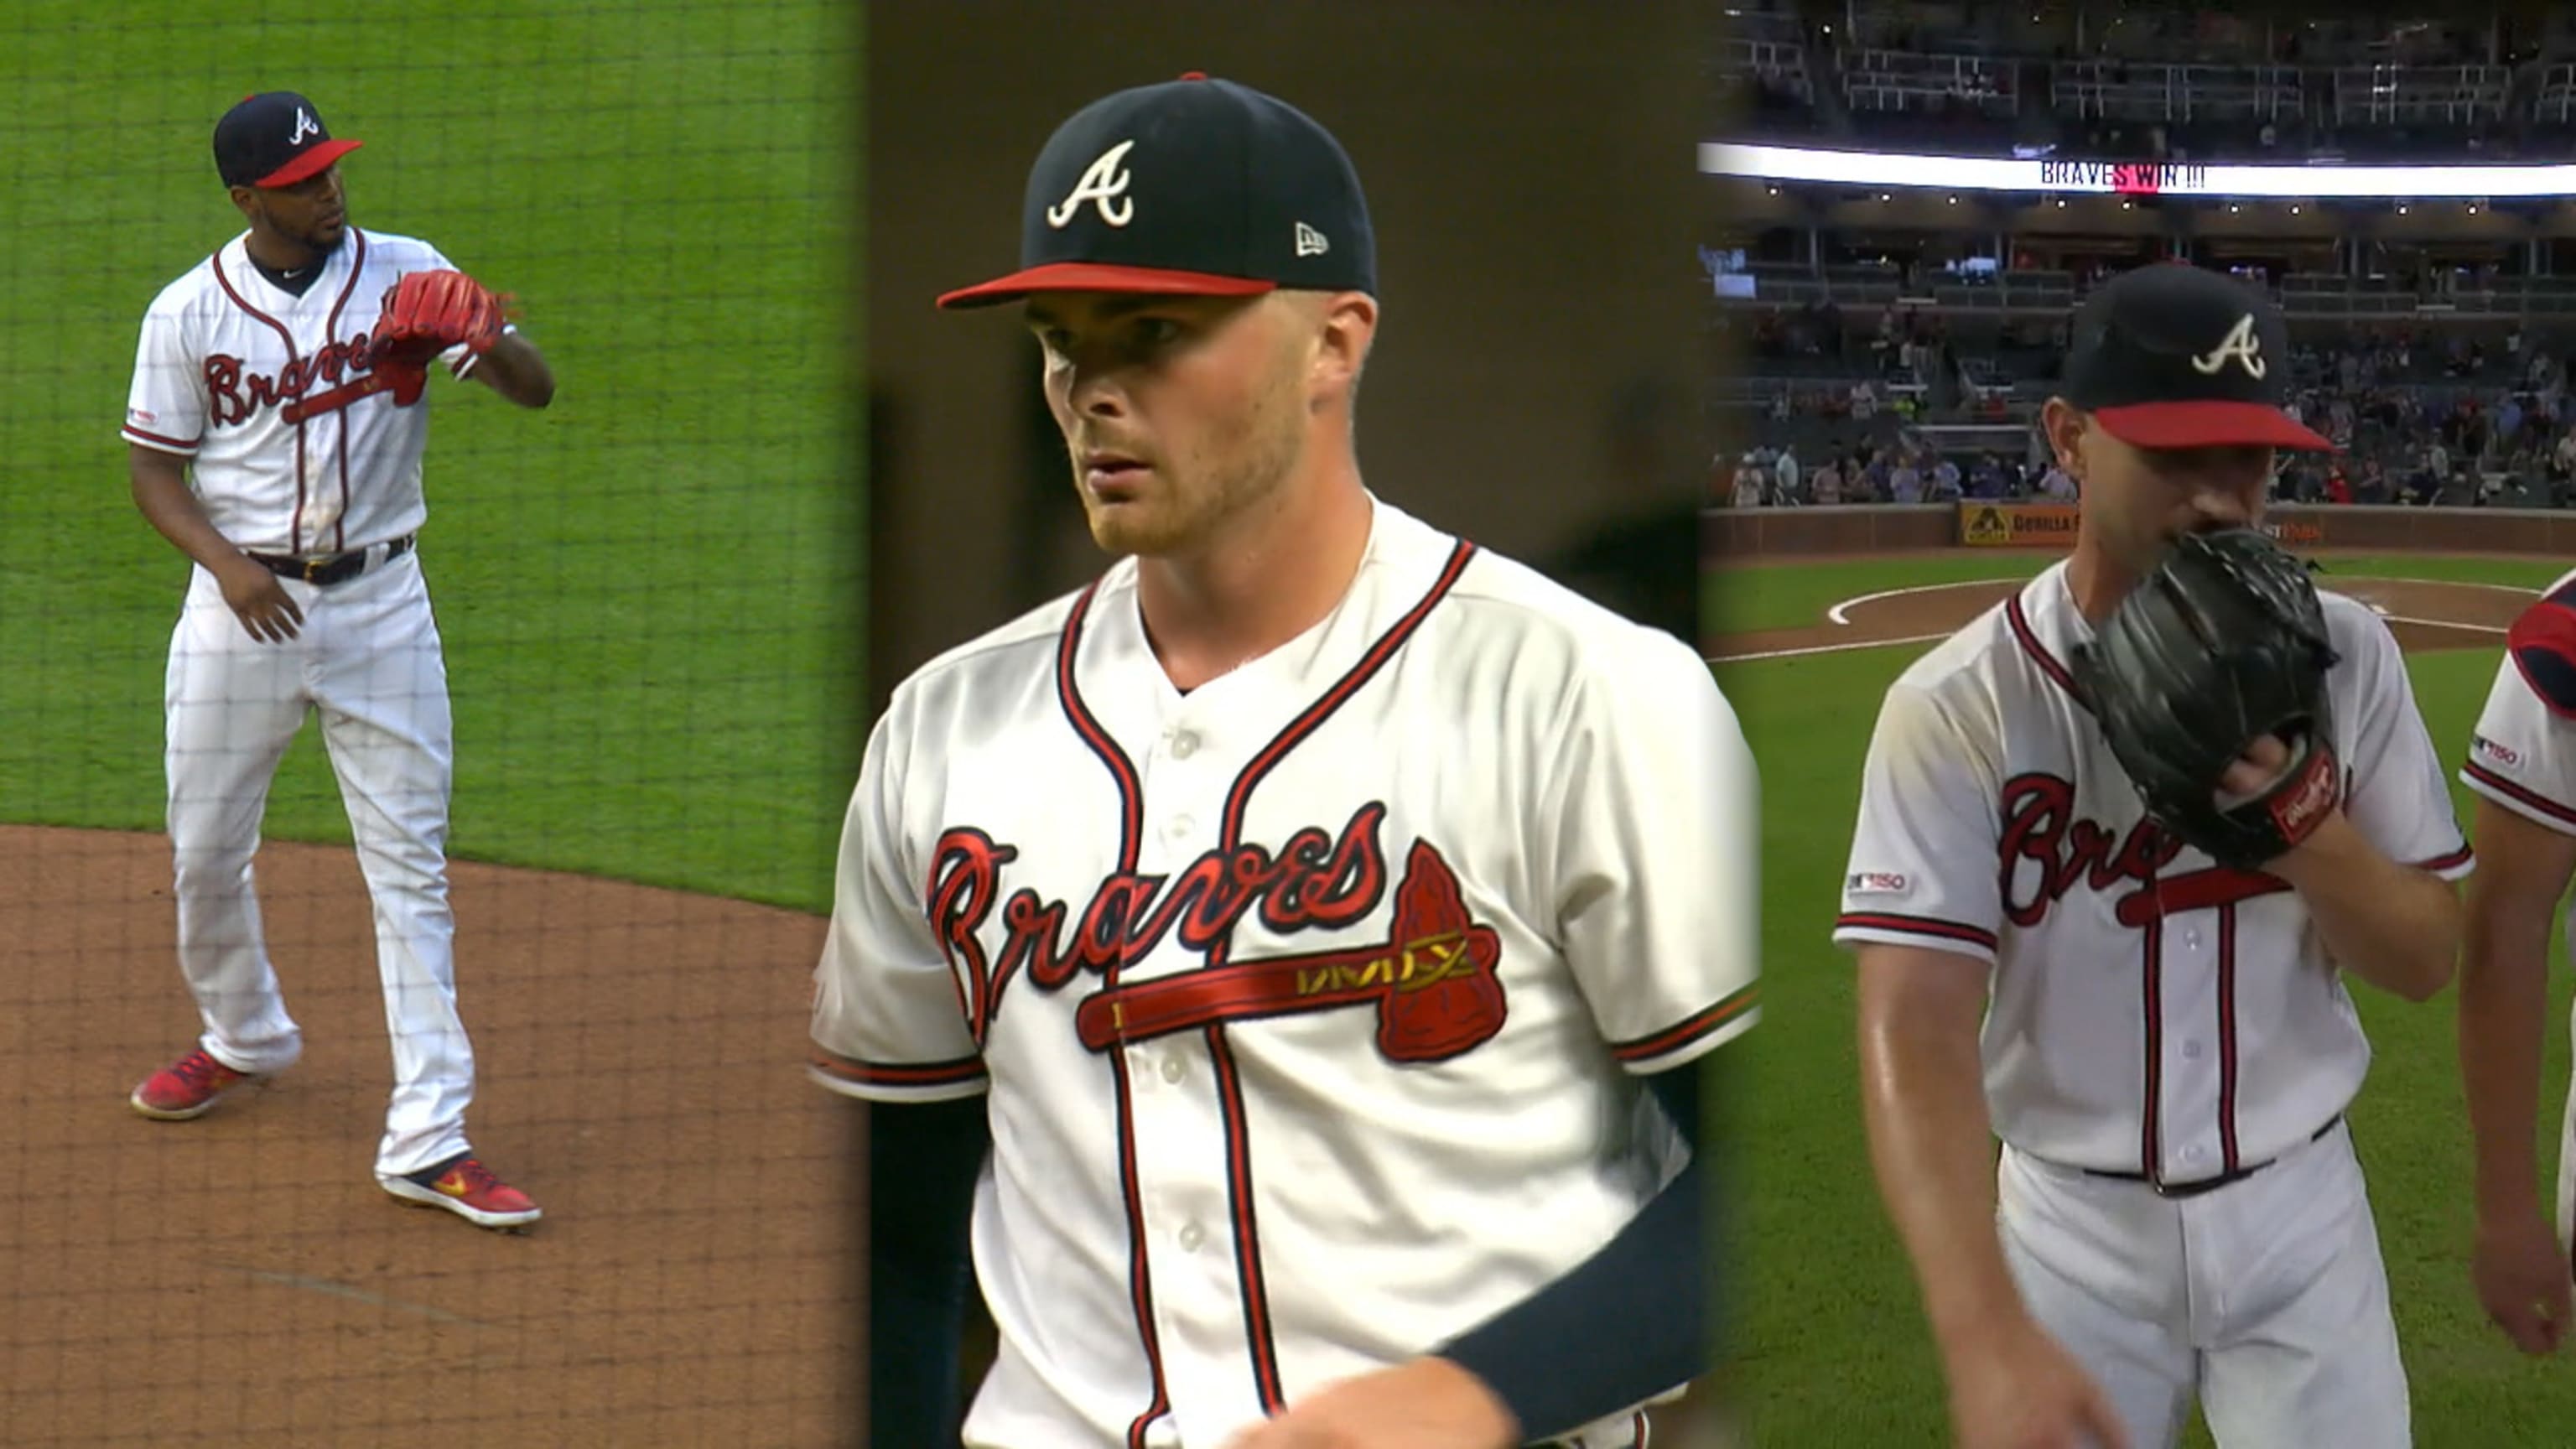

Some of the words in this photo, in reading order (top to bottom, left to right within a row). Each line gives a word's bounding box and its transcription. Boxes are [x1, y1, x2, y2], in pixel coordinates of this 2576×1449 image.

[1047, 140, 1135, 227] A
[2041, 160, 2127, 185] BRAVES
[2136, 164, 2179, 188] WIN
[205, 332, 375, 429] Brave
[2192, 313, 2266, 380] A
[927, 800, 1386, 1053] Braves
